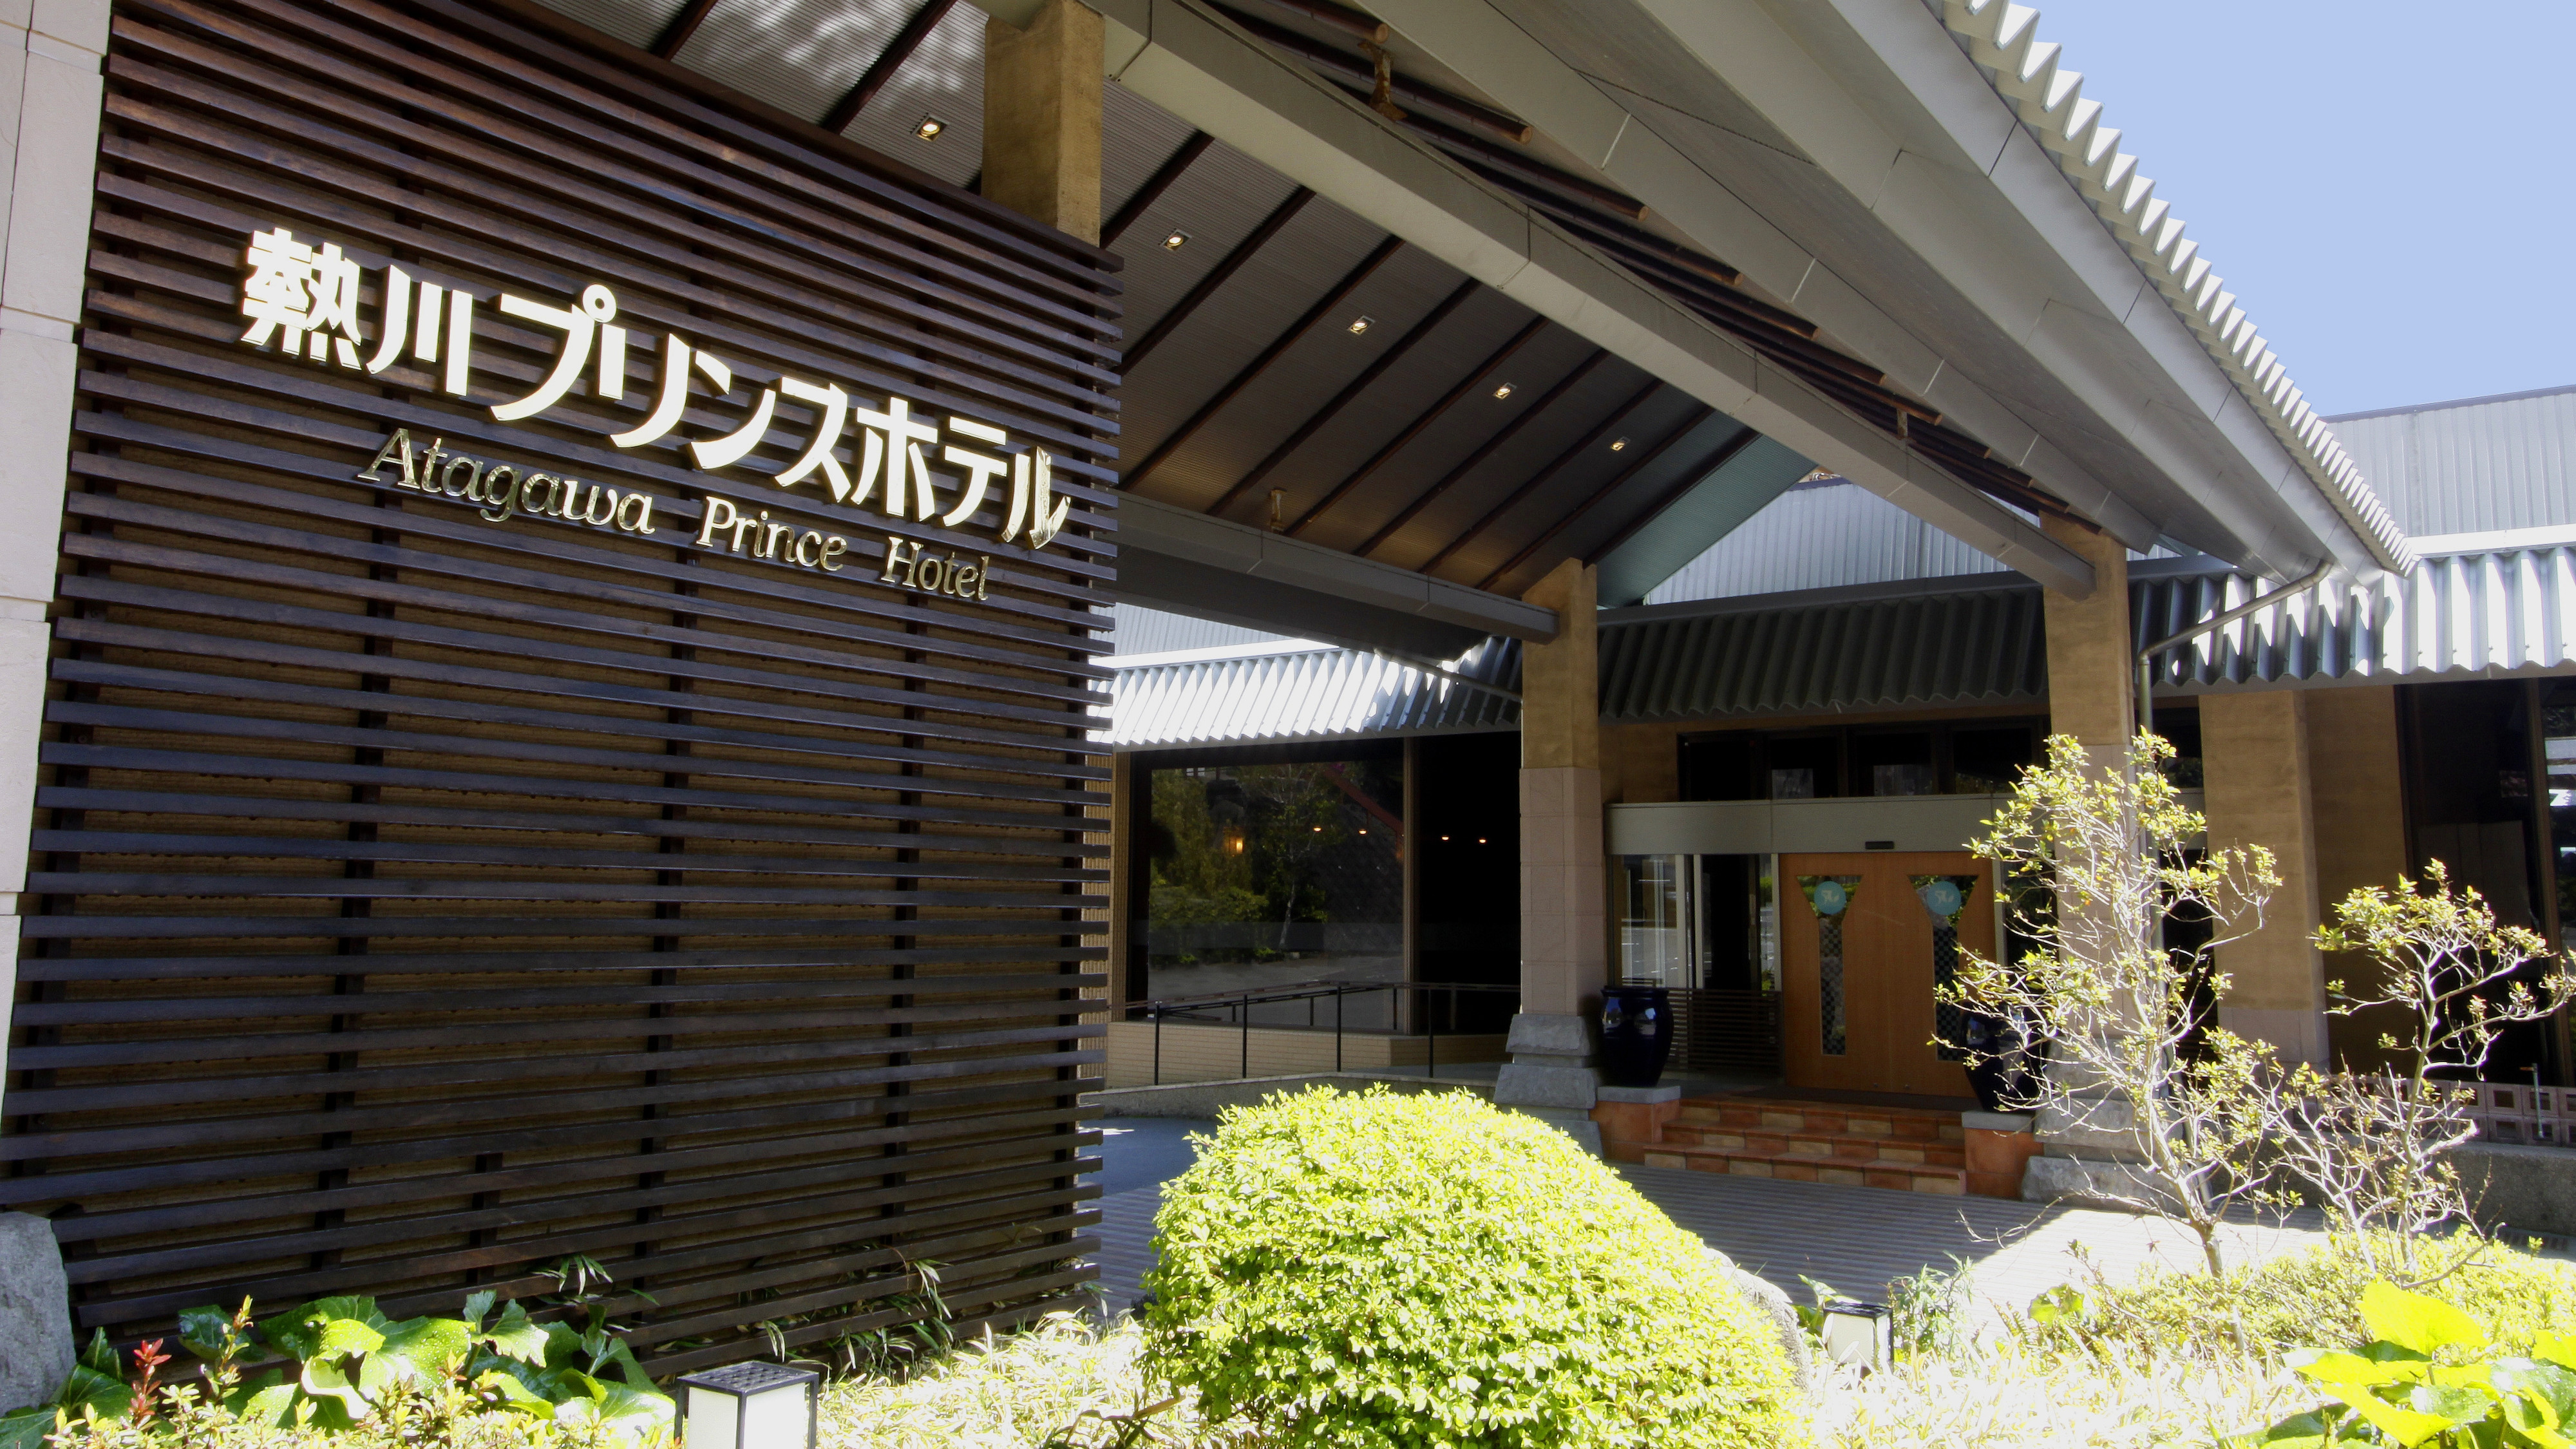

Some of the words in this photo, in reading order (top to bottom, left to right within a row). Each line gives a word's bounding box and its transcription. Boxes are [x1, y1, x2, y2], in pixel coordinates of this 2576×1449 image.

[241, 227, 1070, 549] 熱川プリンスホテル
[357, 428, 656, 535] Atagawa
[696, 495, 848, 572] Prince
[881, 536, 989, 601] Hotel
